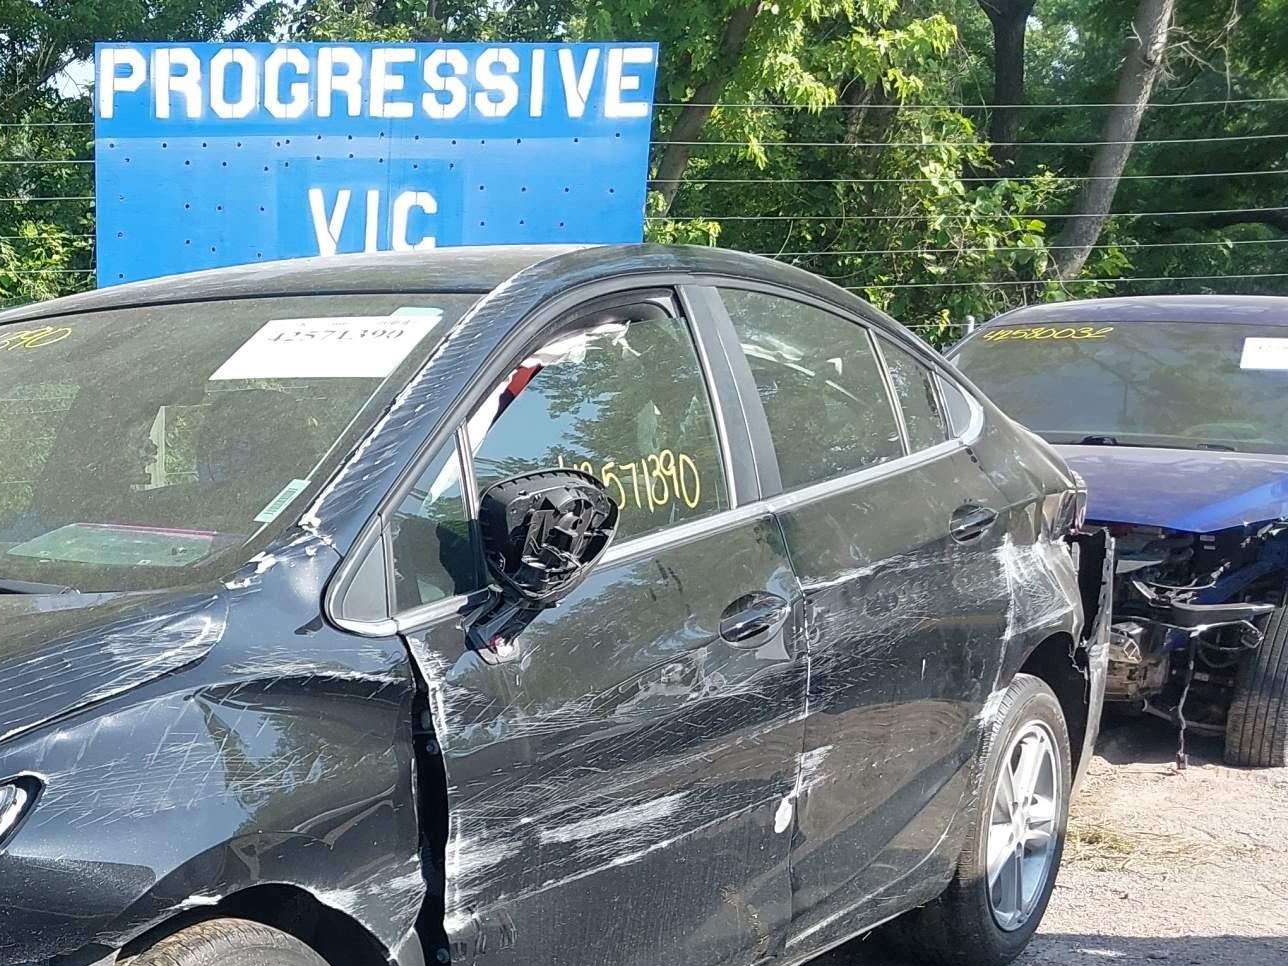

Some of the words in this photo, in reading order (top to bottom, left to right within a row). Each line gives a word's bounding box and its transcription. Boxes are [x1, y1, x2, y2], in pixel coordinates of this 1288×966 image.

[99, 46, 655, 119] PROGRESSIVE
[308, 188, 438, 257] VIC
[558, 449, 701, 513] 571390
